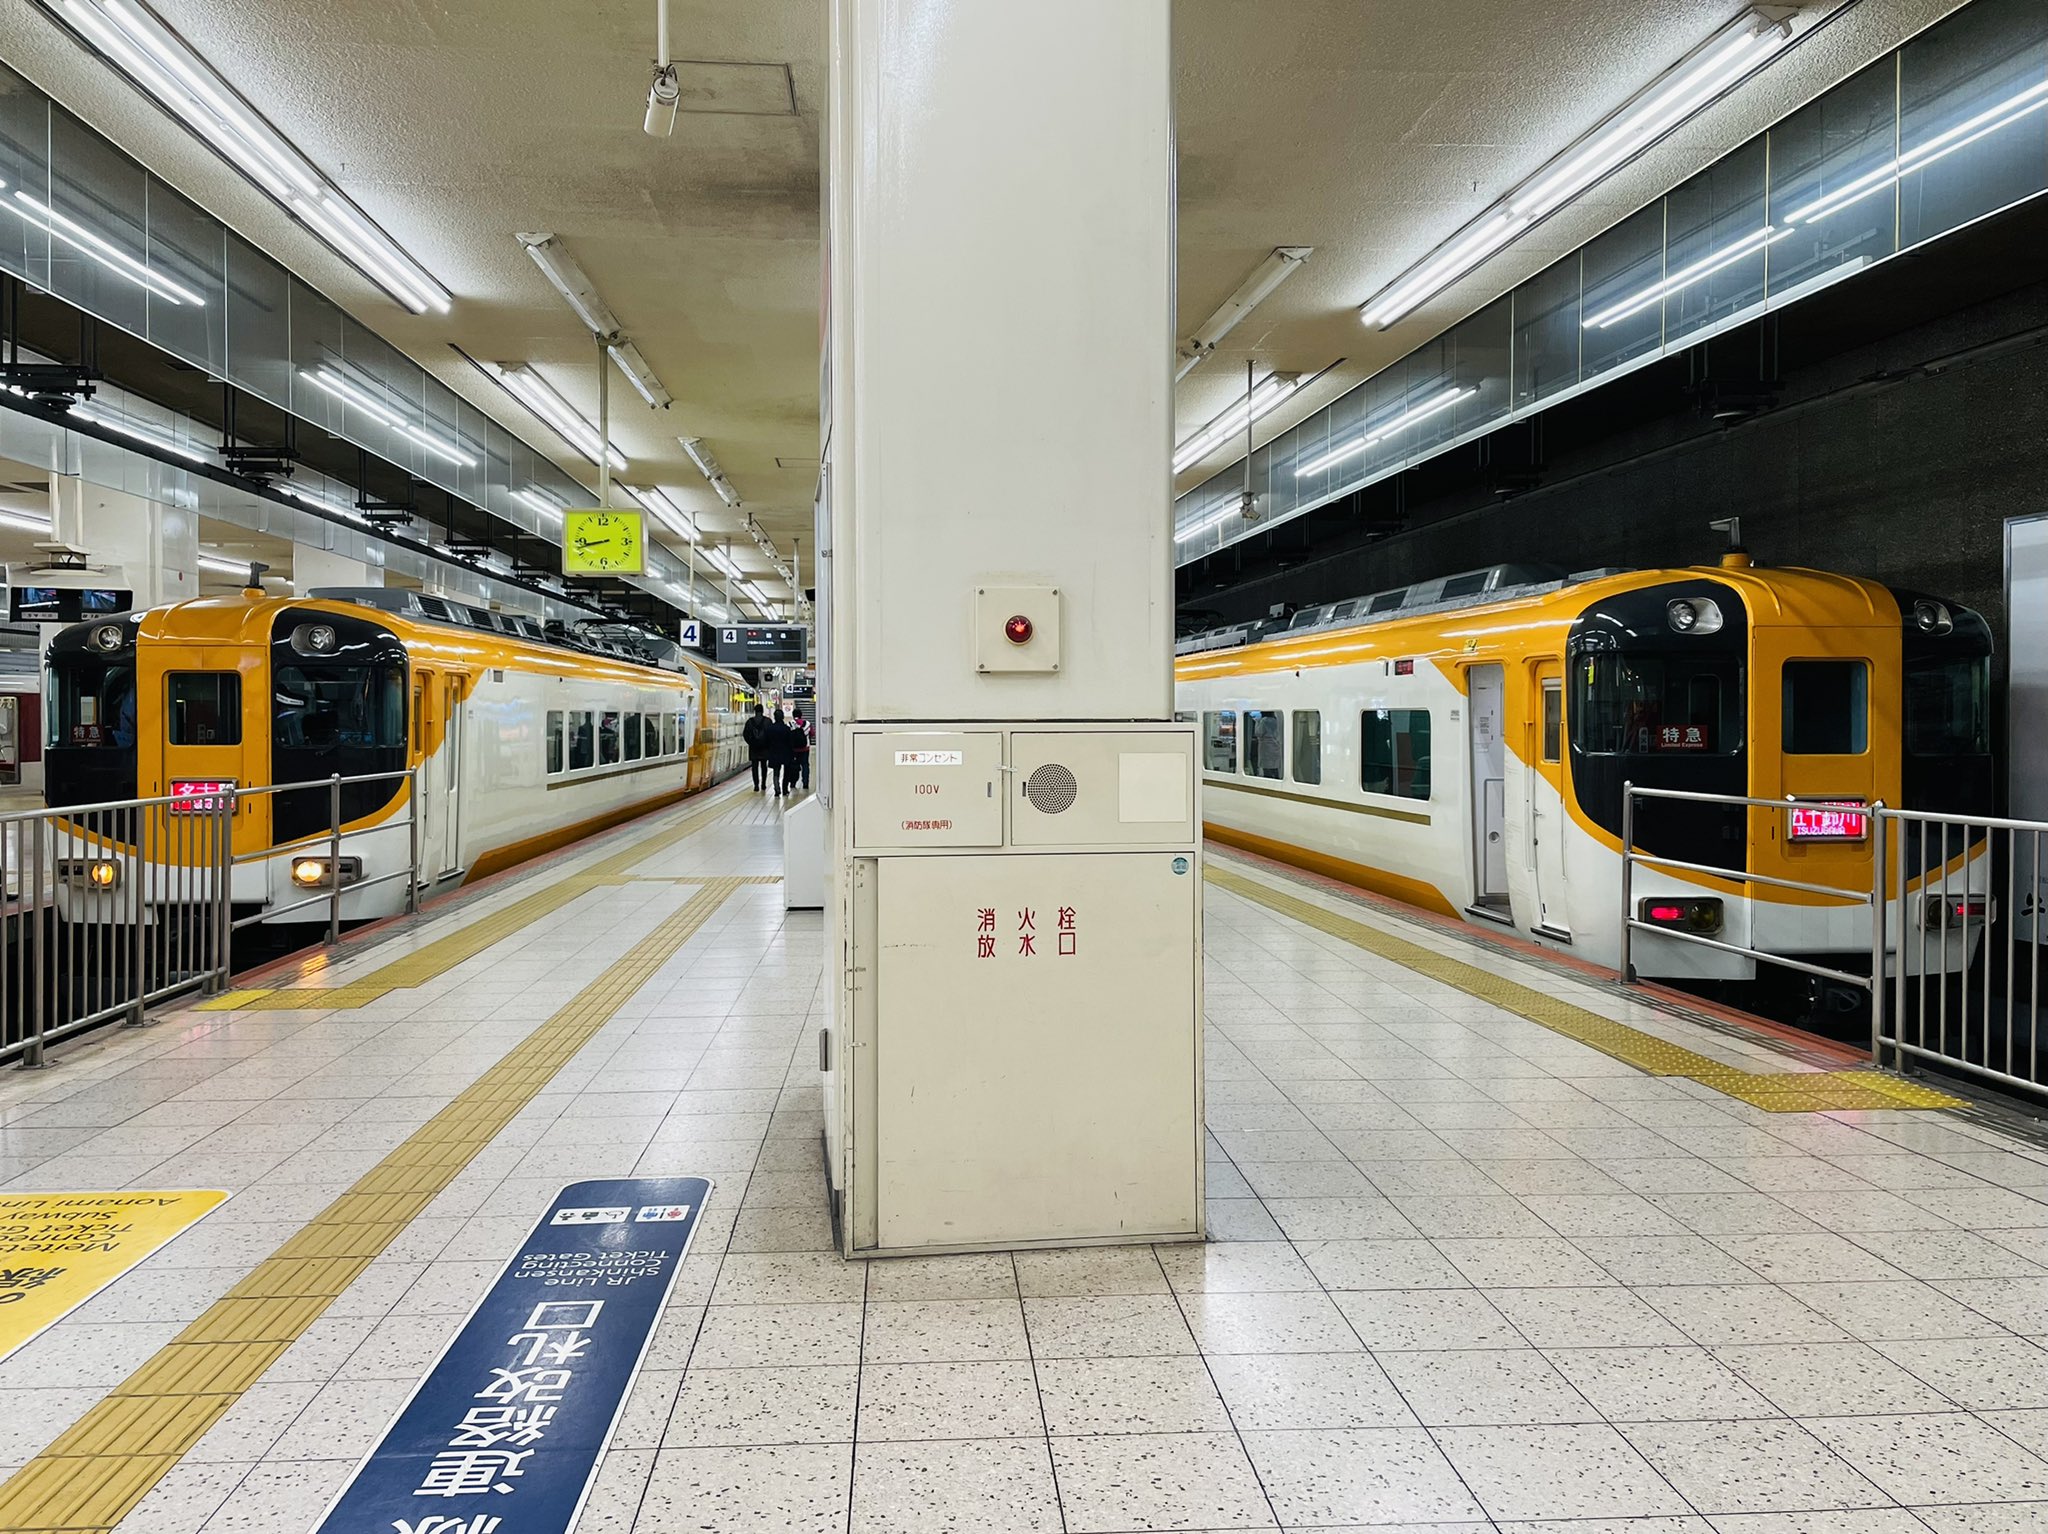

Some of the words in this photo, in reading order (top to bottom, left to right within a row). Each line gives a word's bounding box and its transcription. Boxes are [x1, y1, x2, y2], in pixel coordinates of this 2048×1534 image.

[598, 517, 609, 526] 12
[579, 537, 587, 546] 9
[621, 537, 628, 546] 3
[600, 557, 608, 566] 6
[683, 625, 697, 642] 4
[725, 631, 735, 641] 4
[73, 725, 101, 738] 特急
[1662, 727, 1702, 742] 特急
[901, 753, 958, 763] 非常コンセント
[914, 784, 940, 795] 100V
[54, 1198, 183, 1209] Aonami
[0, 1211, 118, 1222] Subway
[39, 1223, 135, 1233] Ticket
[523, 1252, 589, 1261] Gates
[600, 1250, 670, 1260] Ticket
[520, 1259, 662, 1270] Connecting
[514, 1267, 661, 1279] Shinkansen
[543, 1277, 598, 1287] Line
[606, 1276, 637, 1286] JR
[412, 1299, 606, 1498] 連絡改札口
